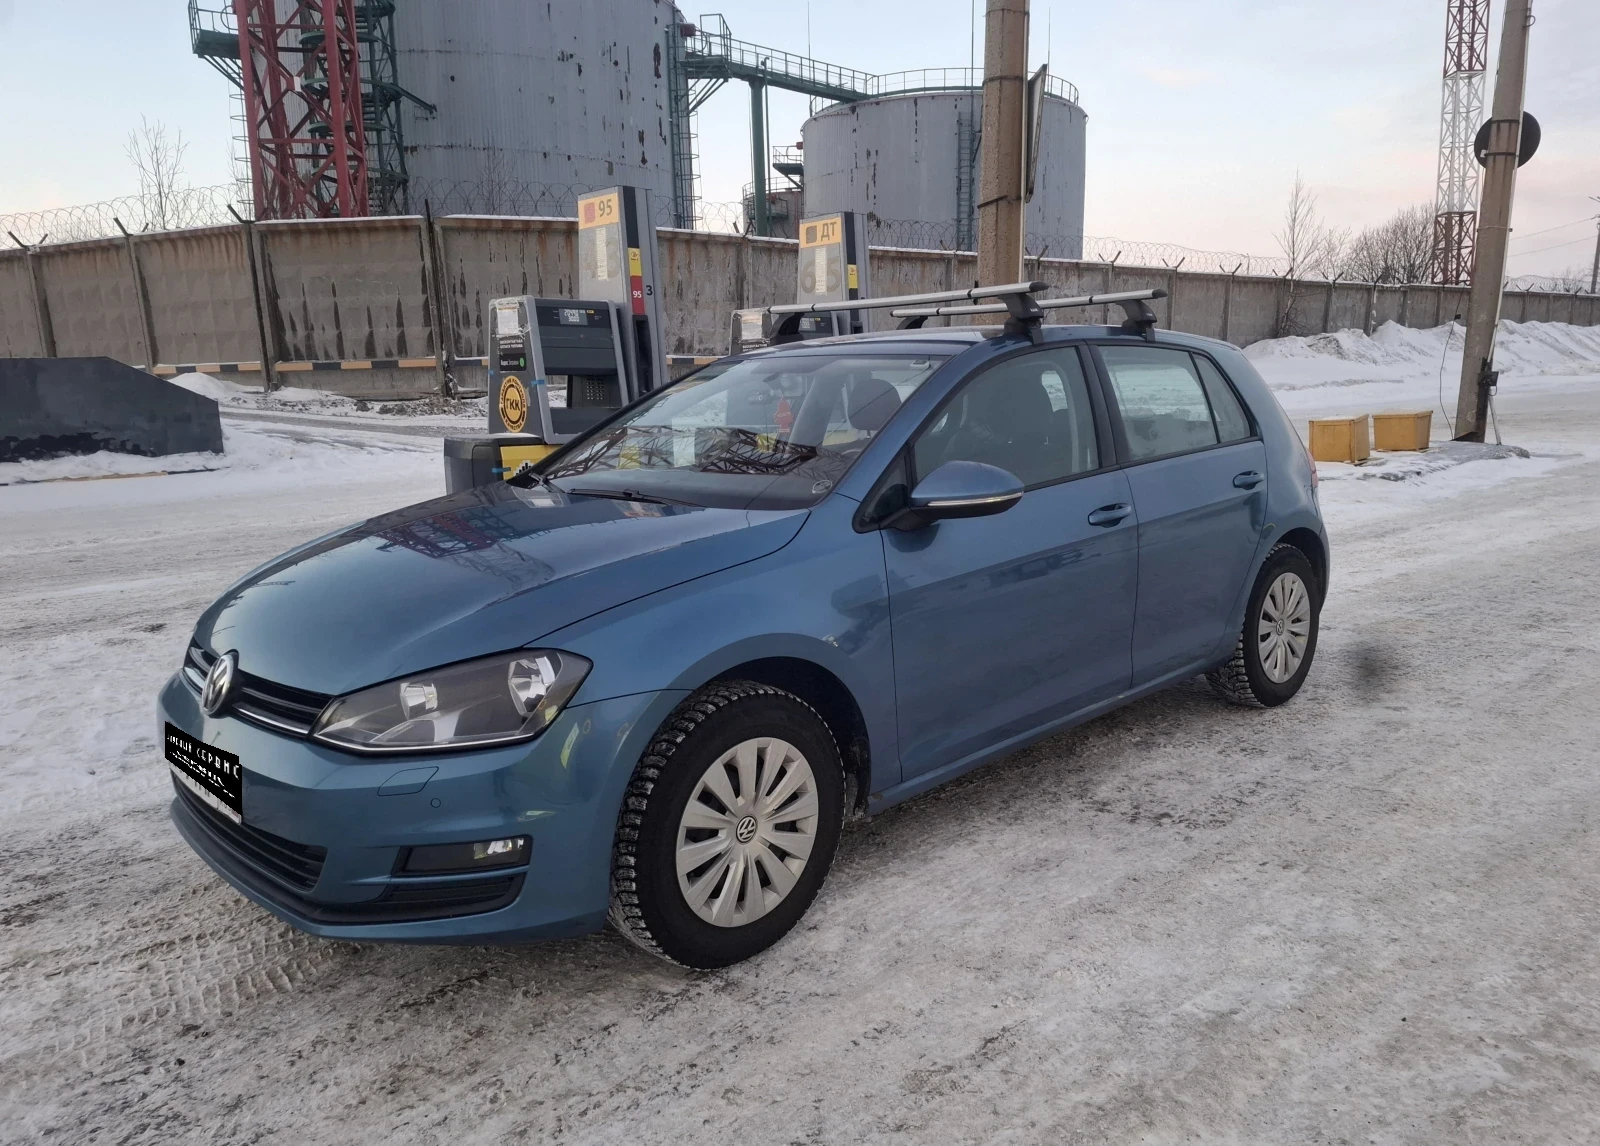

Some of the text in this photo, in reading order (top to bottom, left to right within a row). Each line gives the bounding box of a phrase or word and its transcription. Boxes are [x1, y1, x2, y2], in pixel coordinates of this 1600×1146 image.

[598, 199, 613, 217] 95
[821, 222, 837, 241] ДТ
[632, 290, 642, 298] 95
[645, 285, 653, 296] 3
